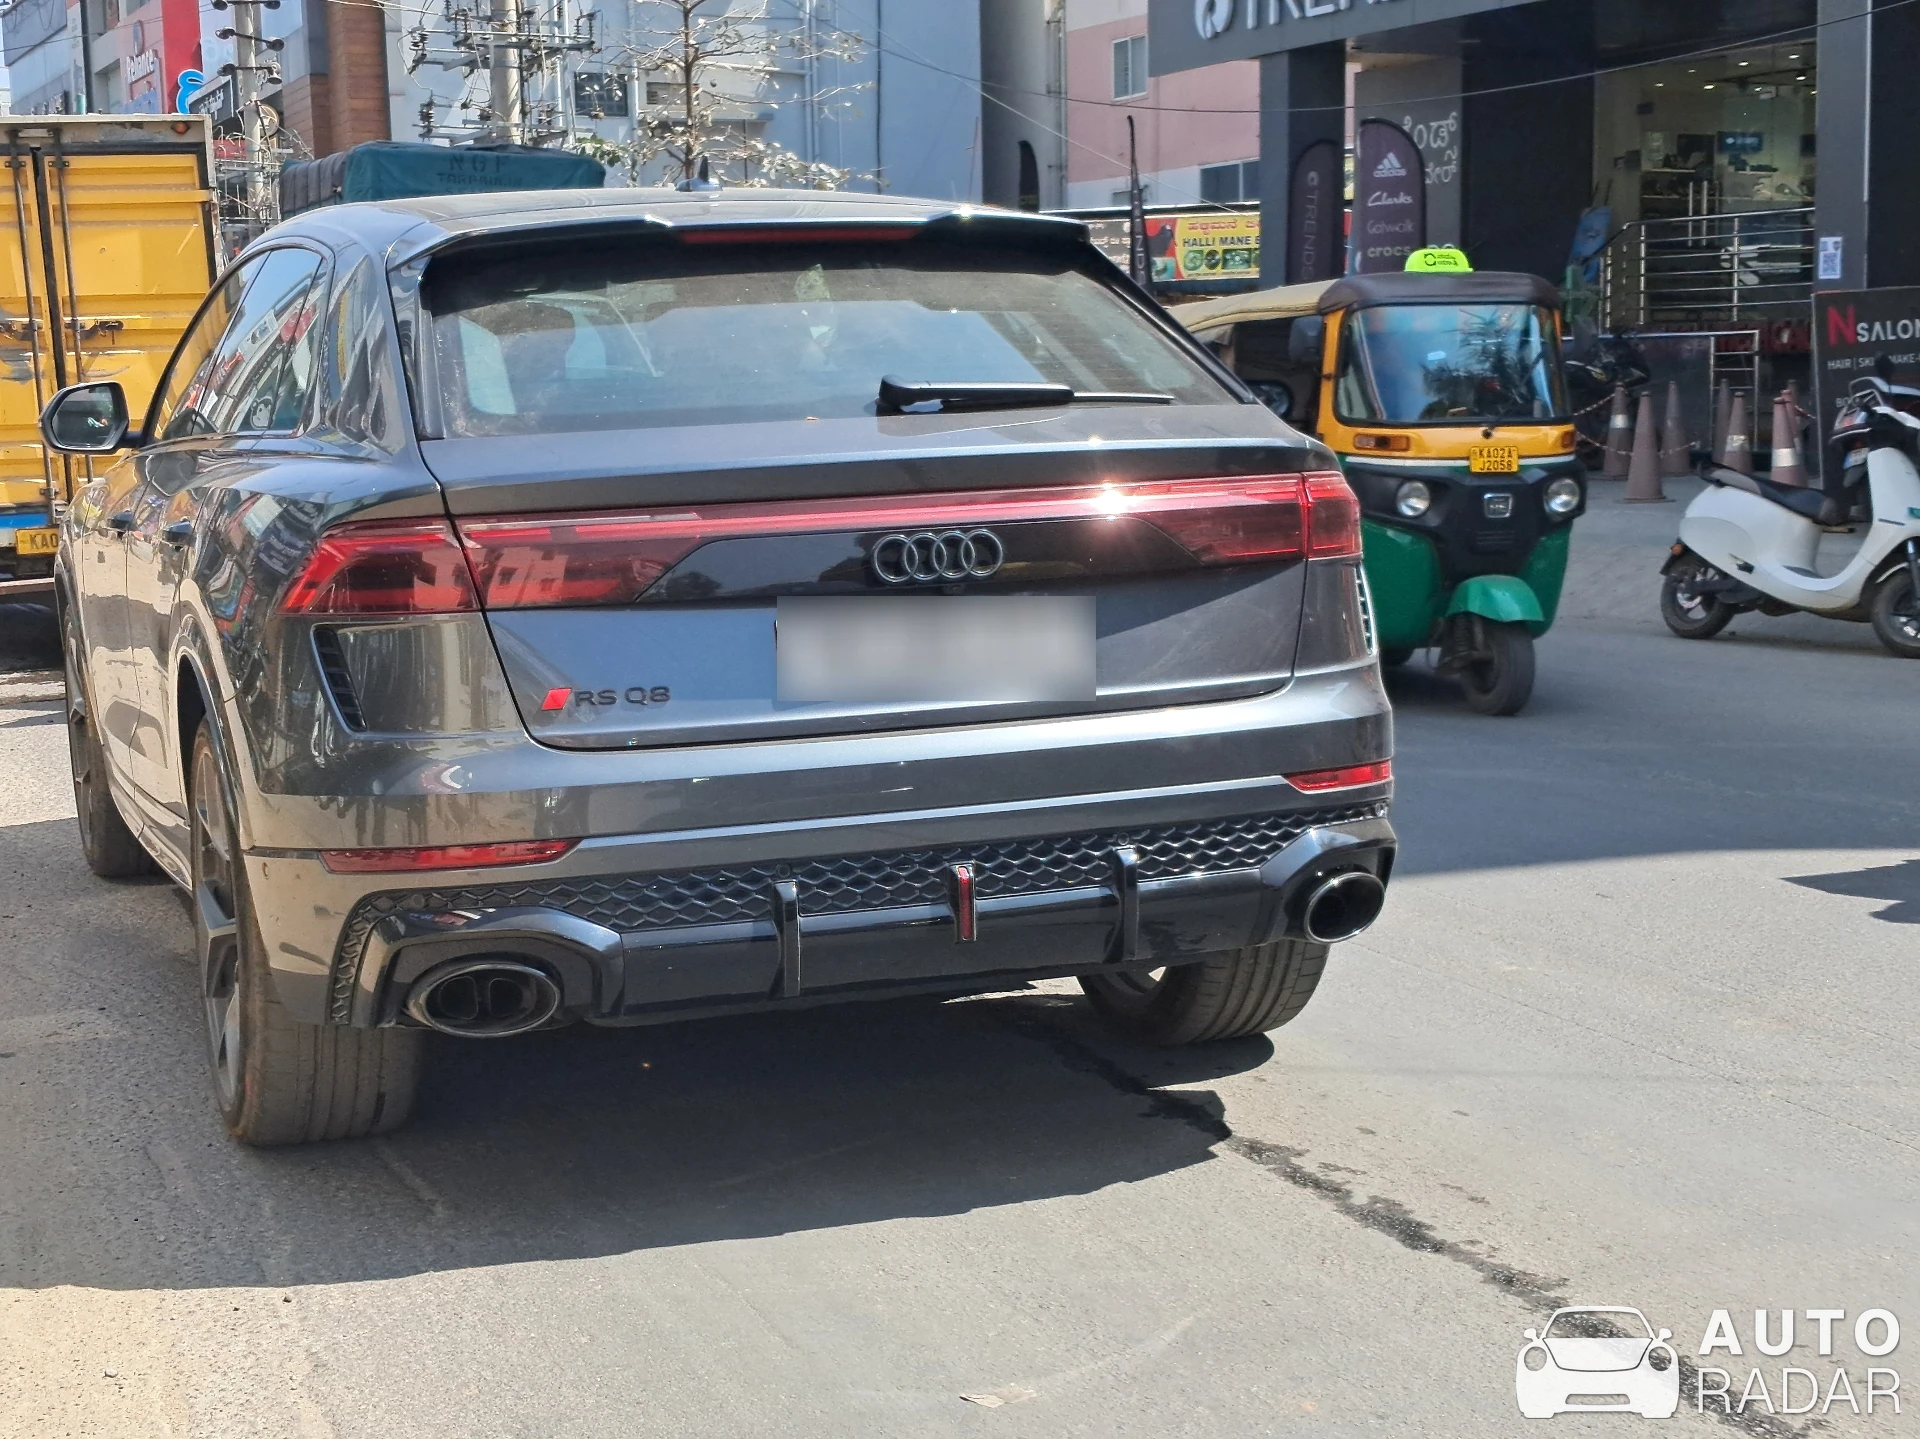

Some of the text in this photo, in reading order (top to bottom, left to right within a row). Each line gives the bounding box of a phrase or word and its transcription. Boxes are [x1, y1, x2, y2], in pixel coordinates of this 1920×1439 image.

[1373, 168, 1406, 178] adidas
[1367, 191, 1413, 207] Clarks
[1182, 236, 1215, 247] HALLI
[1219, 235, 1251, 246] MANE
[1367, 246, 1411, 258] crocs
[1827, 358, 1852, 370] HAIR
[1479, 448, 1512, 459] KA02A
[1480, 460, 1512, 471] J2058
[574, 686, 671, 707] RS Q8
